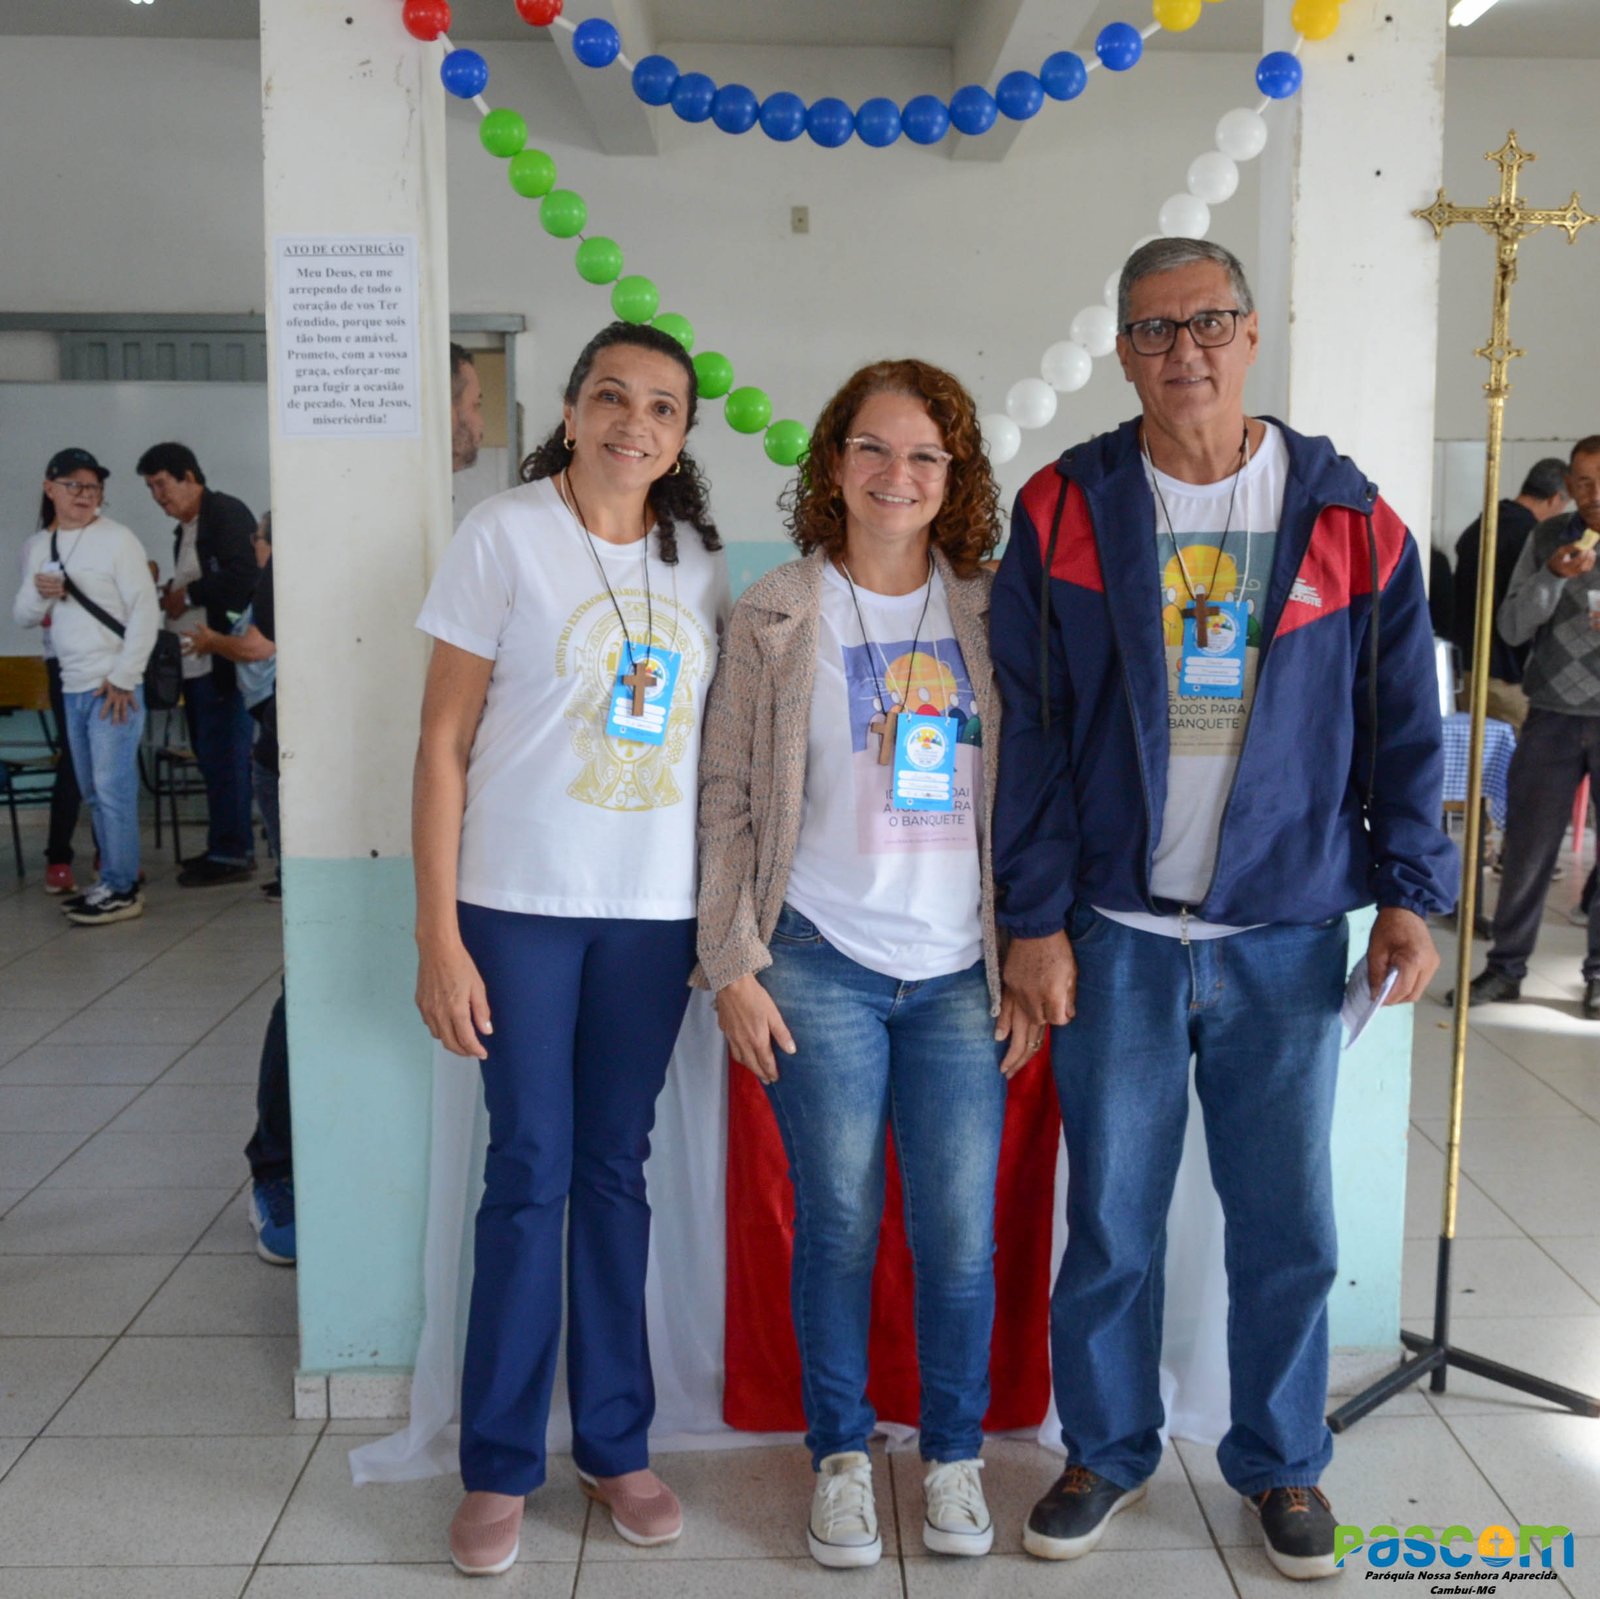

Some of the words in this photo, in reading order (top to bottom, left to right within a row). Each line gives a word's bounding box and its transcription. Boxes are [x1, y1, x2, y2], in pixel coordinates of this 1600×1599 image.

[285, 245, 309, 254] ATO
[311, 245, 326, 254] DE
[330, 242, 405, 254] CONTRIÇÃO
[297, 268, 322, 278] Meu
[325, 268, 357, 278] Deus,
[288, 284, 348, 296] arrependo
[350, 284, 364, 294] de
[367, 284, 392, 293] todo
[292, 301, 337, 312] coração
[340, 301, 354, 310] de
[285, 317, 339, 327] ofendido,
[342, 319, 382, 329] porque
[385, 316, 406, 326] sois
[296, 334, 313, 343] tão
[316, 334, 342, 343] bom
[287, 350, 339, 359] Prometo,
[295, 369, 330, 378] graça,
[333, 366, 400, 376] esforçar-me
[293, 385, 319, 395] para
[322, 383, 350, 393] fugir
[363, 382, 404, 391] ocasião
[287, 399, 301, 408] de
[304, 399, 346, 411] pecado.
[350, 398, 375, 408] Meu
[378, 398, 412, 408] Jesus,
[312, 414, 387, 424] misericórdia!
[1168, 704, 1207, 715] ODOS
[1210, 704, 1246, 714] PARA
[1168, 718, 1240, 731] BANQUETE
[889, 816, 898, 827] O
[902, 814, 965, 827] BANQUETE
